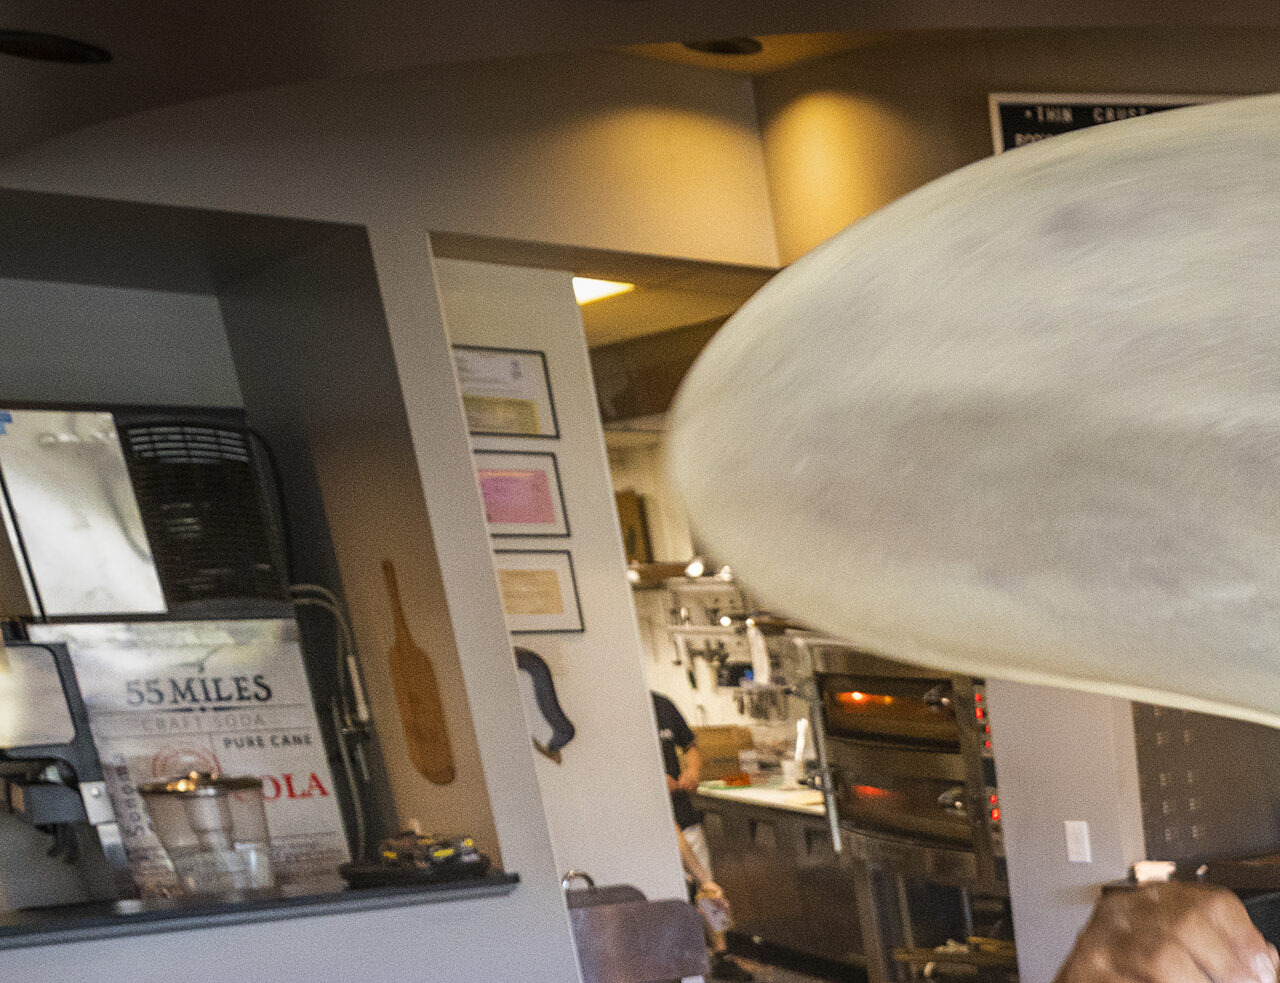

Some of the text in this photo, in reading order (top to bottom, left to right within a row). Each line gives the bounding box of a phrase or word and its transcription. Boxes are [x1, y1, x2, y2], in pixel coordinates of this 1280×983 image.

[126, 674, 273, 706] 55 MILES
[216, 713, 268, 731] SODA
[222, 731, 314, 749] PURE CANE
[230, 771, 330, 803] OLA
